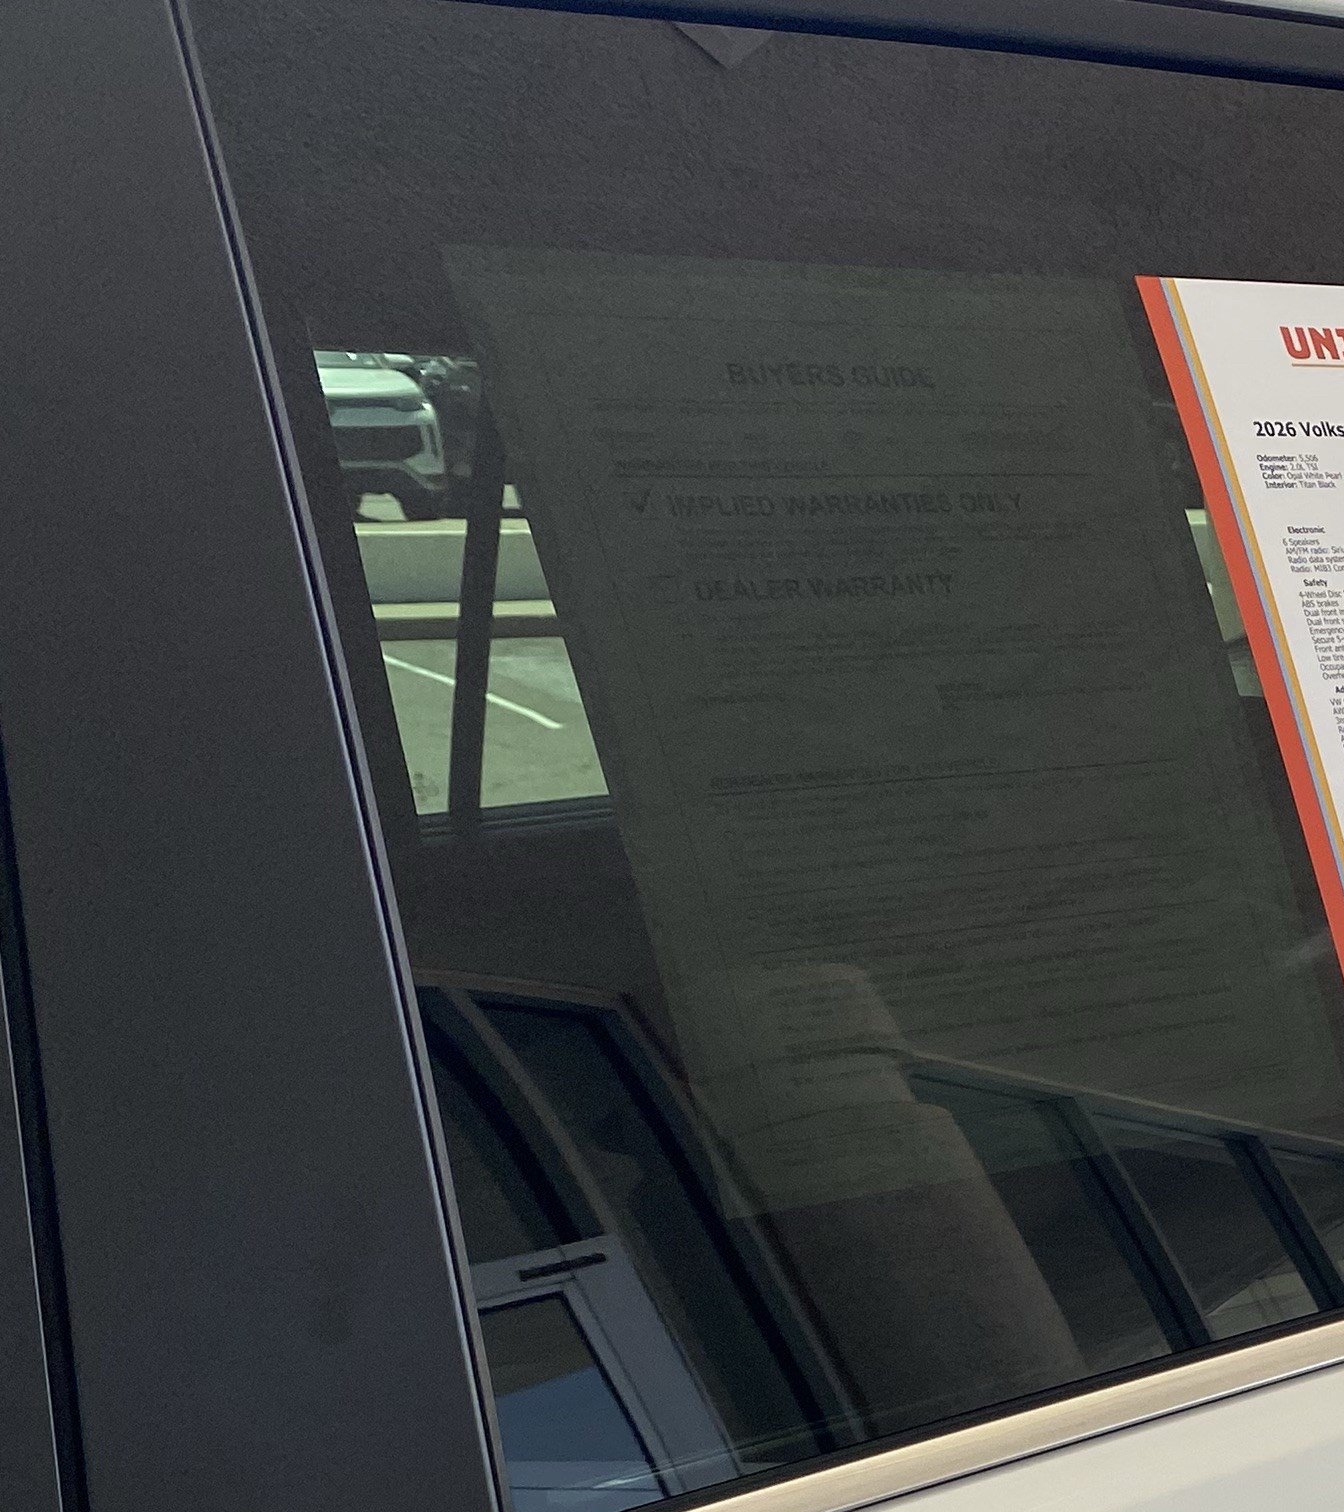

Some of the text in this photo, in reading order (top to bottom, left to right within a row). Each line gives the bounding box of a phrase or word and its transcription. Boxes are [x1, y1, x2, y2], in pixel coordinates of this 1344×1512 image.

[727, 361, 936, 390] BUYERS GUIDE
[1253, 421, 1297, 437] 2026
[1256, 454, 1297, 462] Odometer:
[1260, 463, 1288, 472] Engine:
[1307, 463, 1318, 471] TSI
[1262, 472, 1285, 480] Color:
[1305, 472, 1324, 480] White
[1325, 472, 1342, 480] Pearl
[1265, 480, 1336, 489] Interior: Titan Black
[666, 490, 1022, 518] IMPLIED WARRANTIES ONLY
[1287, 526, 1326, 534] Electronic
[1286, 547, 1309, 555] AM/FM
[1311, 546, 1330, 554] radio:
[1288, 556, 1307, 564] Radio
[1308, 555, 1325, 563] data
[1291, 565, 1313, 573] Radio:
[692, 573, 956, 602] DEALER WARRANTY
[1303, 578, 1328, 588] Safety
[1299, 591, 1327, 599] 4-Wheel
[1328, 590, 1342, 598] Disc
[1304, 609, 1320, 617] Dual
[1321, 608, 1338, 616] front
[1306, 618, 1322, 626] Dual
[1323, 617, 1340, 625] front
[1312, 636, 1335, 644] Secure
[1317, 654, 1331, 663] Low
[1333, 653, 1344, 661] tire
[1329, 698, 1342, 706] VW
